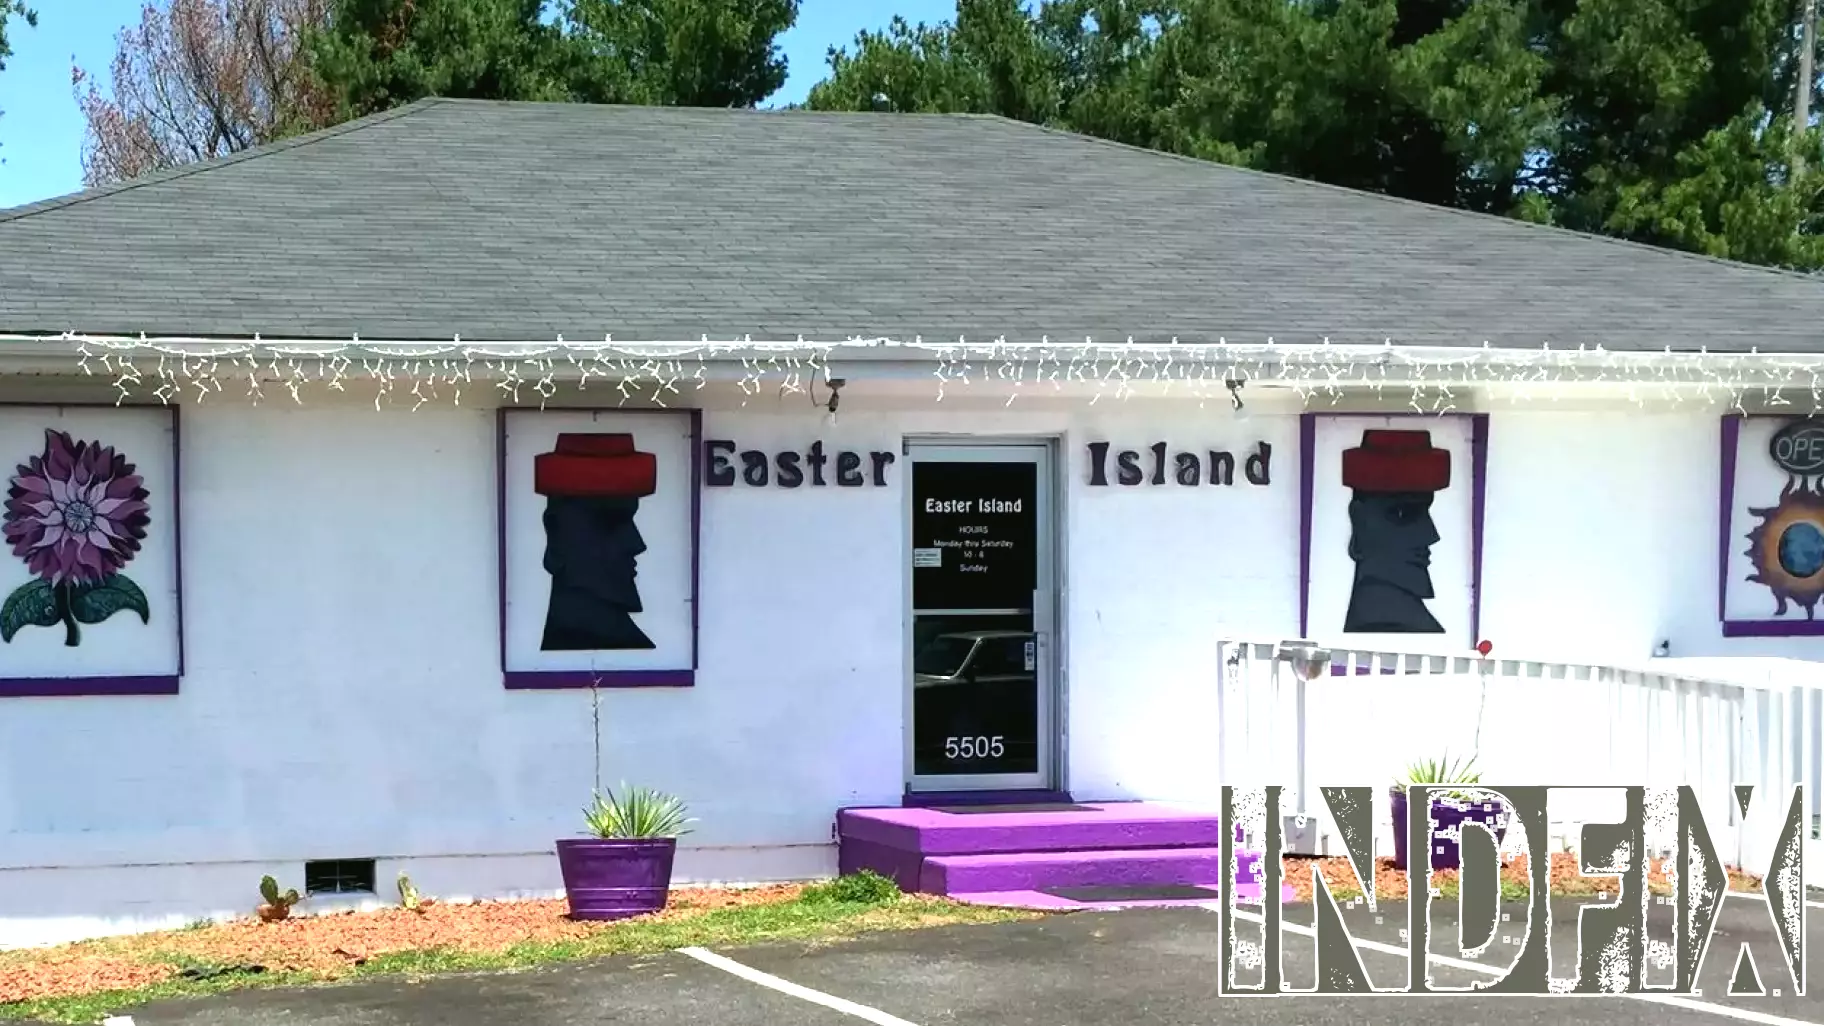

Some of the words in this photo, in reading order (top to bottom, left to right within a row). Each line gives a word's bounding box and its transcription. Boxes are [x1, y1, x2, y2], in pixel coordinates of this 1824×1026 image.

[703, 439, 895, 488] Easter
[1087, 440, 1272, 486] Island
[925, 498, 972, 513] Easter
[978, 498, 1022, 513] Island
[945, 736, 1004, 758] 5505
